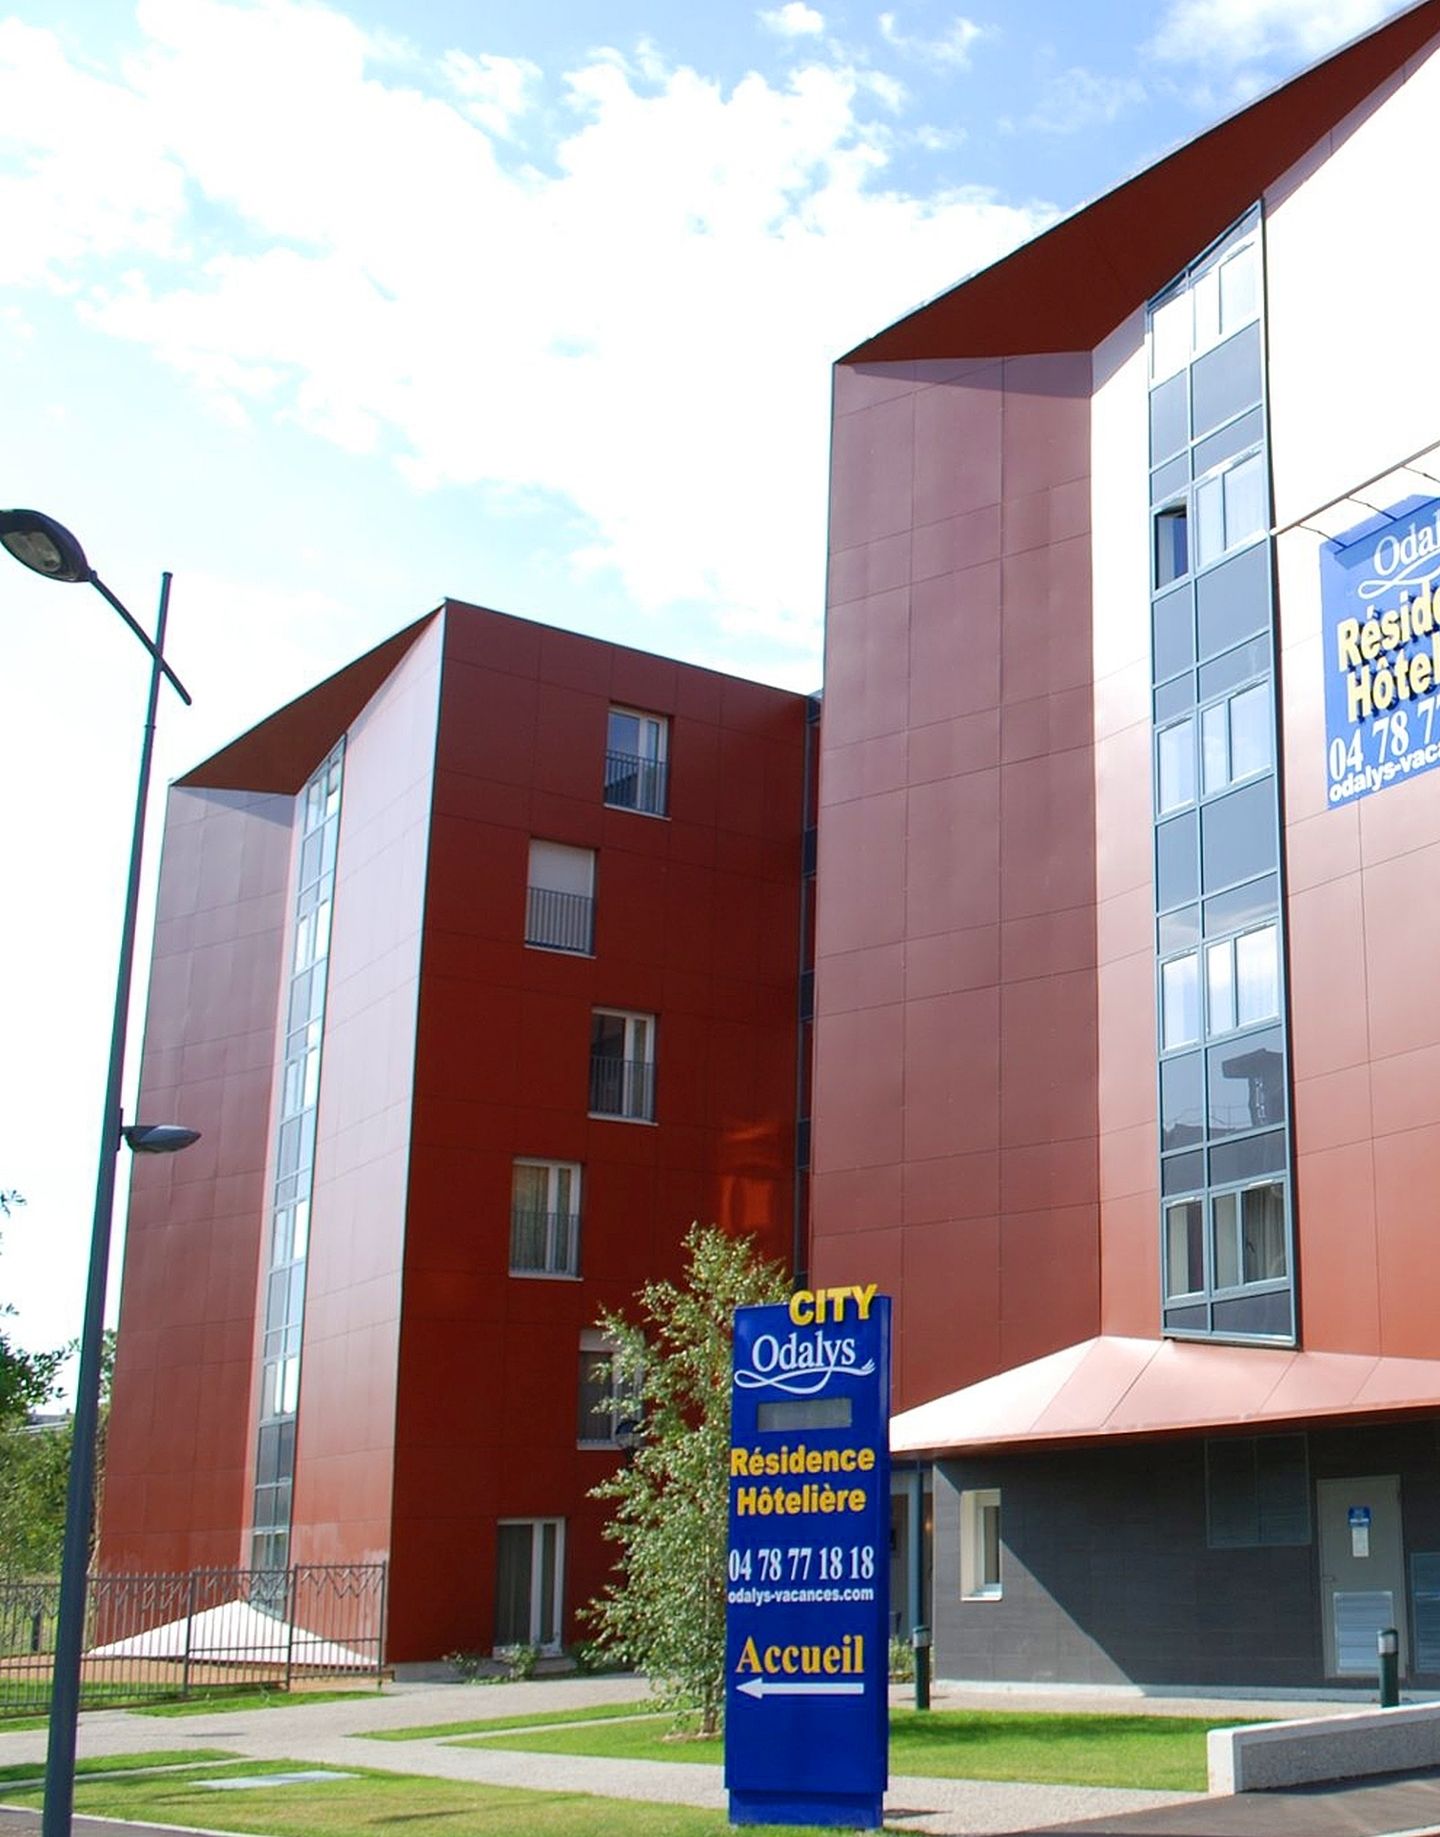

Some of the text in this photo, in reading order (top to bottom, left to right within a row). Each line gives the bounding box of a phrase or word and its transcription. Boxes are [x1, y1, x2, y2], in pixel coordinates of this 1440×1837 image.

[1329, 728, 1364, 781] 04
[1372, 710, 1409, 763] 78
[789, 1284, 877, 1326] CITY
[750, 1330, 858, 1380] Odalys
[730, 1444, 875, 1476] Résidence
[737, 1484, 867, 1516] Hôtelière
[728, 1545, 874, 1582] 04 78 77 18 18
[728, 1587, 874, 1607] odalys-vacances.com
[735, 1634, 864, 1674] Accueil
